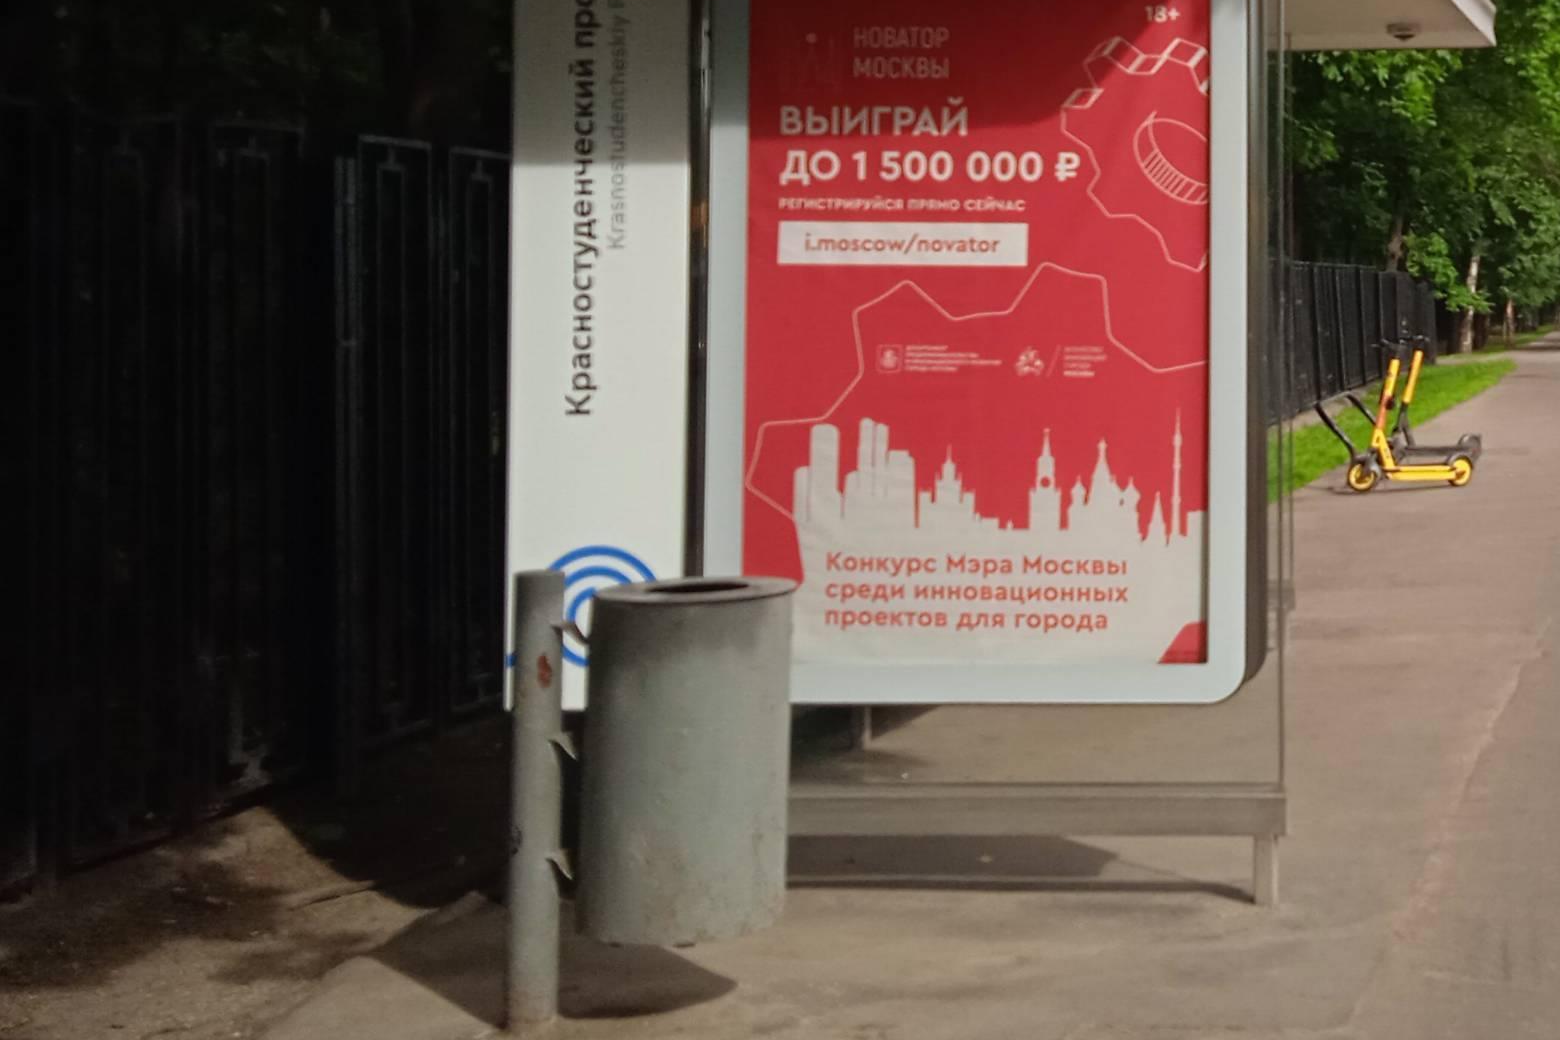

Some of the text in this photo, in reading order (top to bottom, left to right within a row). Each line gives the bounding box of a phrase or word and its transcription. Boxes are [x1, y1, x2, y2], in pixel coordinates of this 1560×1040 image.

[1144, 5, 1181, 23] 18+
[853, 27, 950, 49] НОВАТОР
[853, 57, 950, 80] МОСКВЫ
[779, 97, 969, 136] ВЫИГРАЙ
[606, 15, 629, 251] Krasnostudencheskiy
[779, 149, 841, 186] ДО
[778, 195, 1026, 212] РЕГИСТРИРУЙСЯ ПРЯМО СЕЙЧАС
[563, 58, 602, 418] Красностуденческий
[804, 232, 1000, 255] i.moscow/novator
[825, 552, 1128, 578] Конкурс Мэра Москвы
[825, 582, 1129, 605] среди инновационных
[825, 609, 1109, 634] проектов для города
